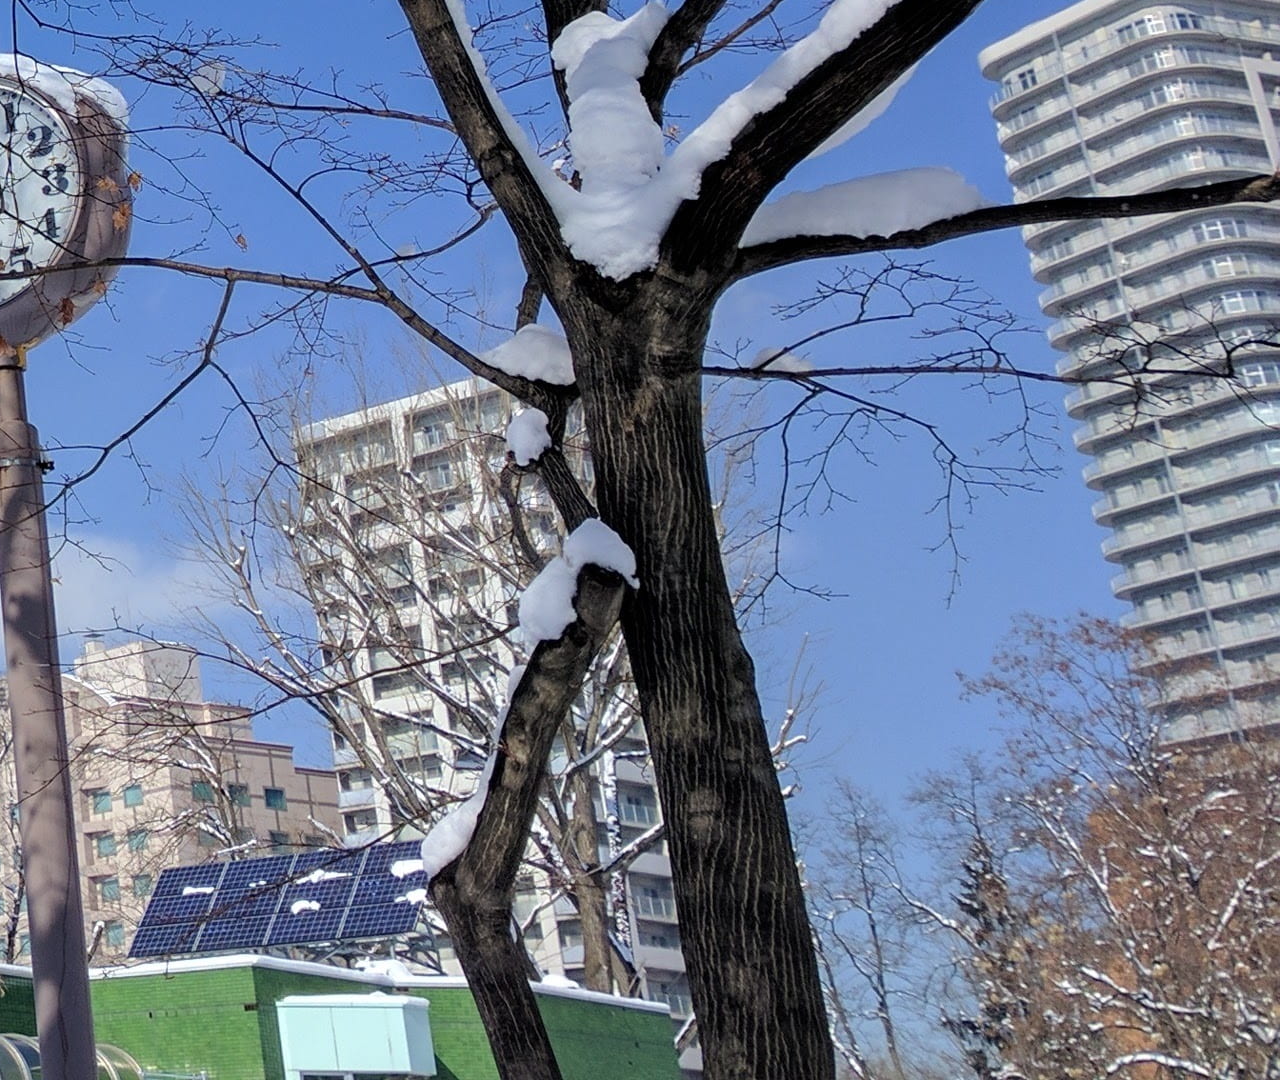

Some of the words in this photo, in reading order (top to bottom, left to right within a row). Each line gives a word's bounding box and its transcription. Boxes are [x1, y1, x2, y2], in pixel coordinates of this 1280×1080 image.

[27, 125, 55, 158] 2
[42, 163, 69, 196] 3
[33, 207, 61, 240] 4
[9, 246, 34, 278] 5
